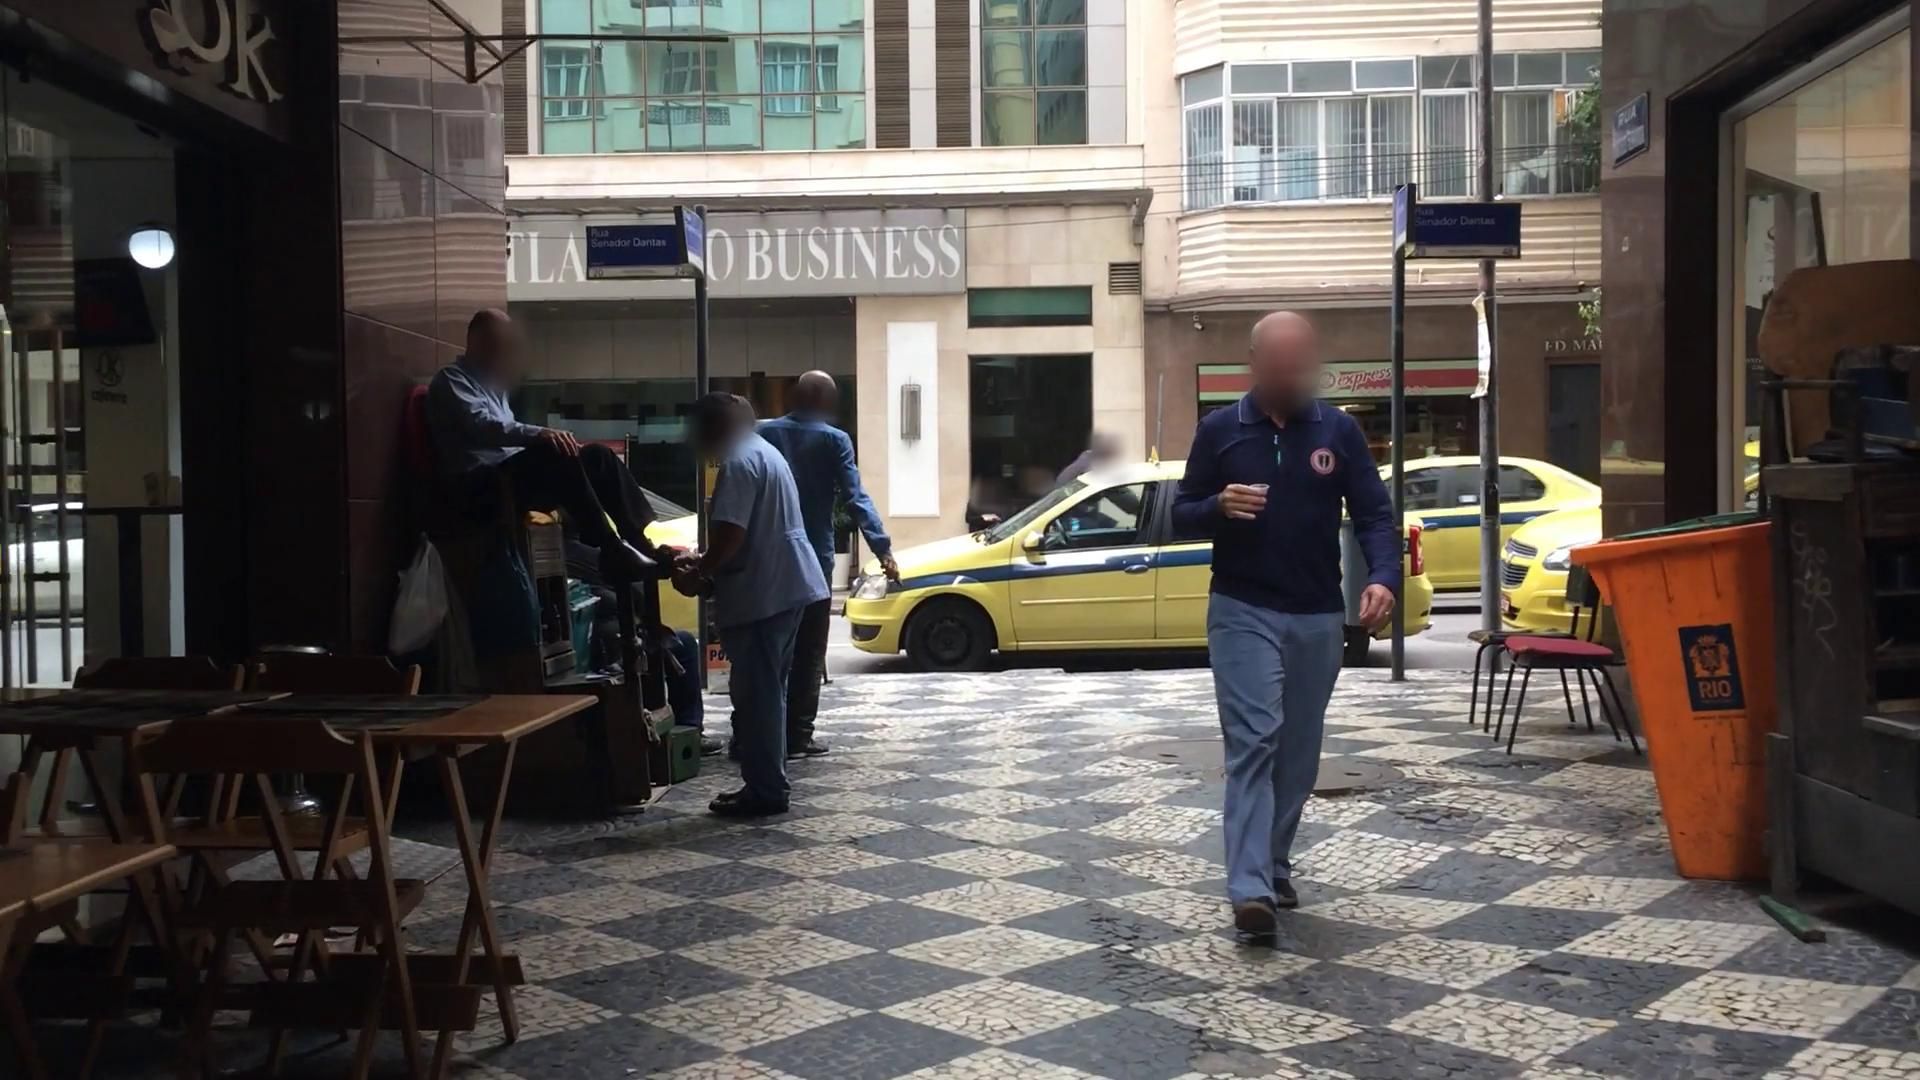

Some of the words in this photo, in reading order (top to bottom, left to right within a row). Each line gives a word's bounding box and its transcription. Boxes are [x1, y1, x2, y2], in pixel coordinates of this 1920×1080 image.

[1415, 216, 1458, 226] Senador
[1460, 215, 1496, 226] Dantas
[591, 228, 609, 237] Rua
[591, 237, 631, 248] Senador
[633, 237, 667, 247] Dantas
[746, 224, 961, 281] BUSINESS
[1338, 367, 1392, 392] express
[1698, 680, 1732, 698] RIO
